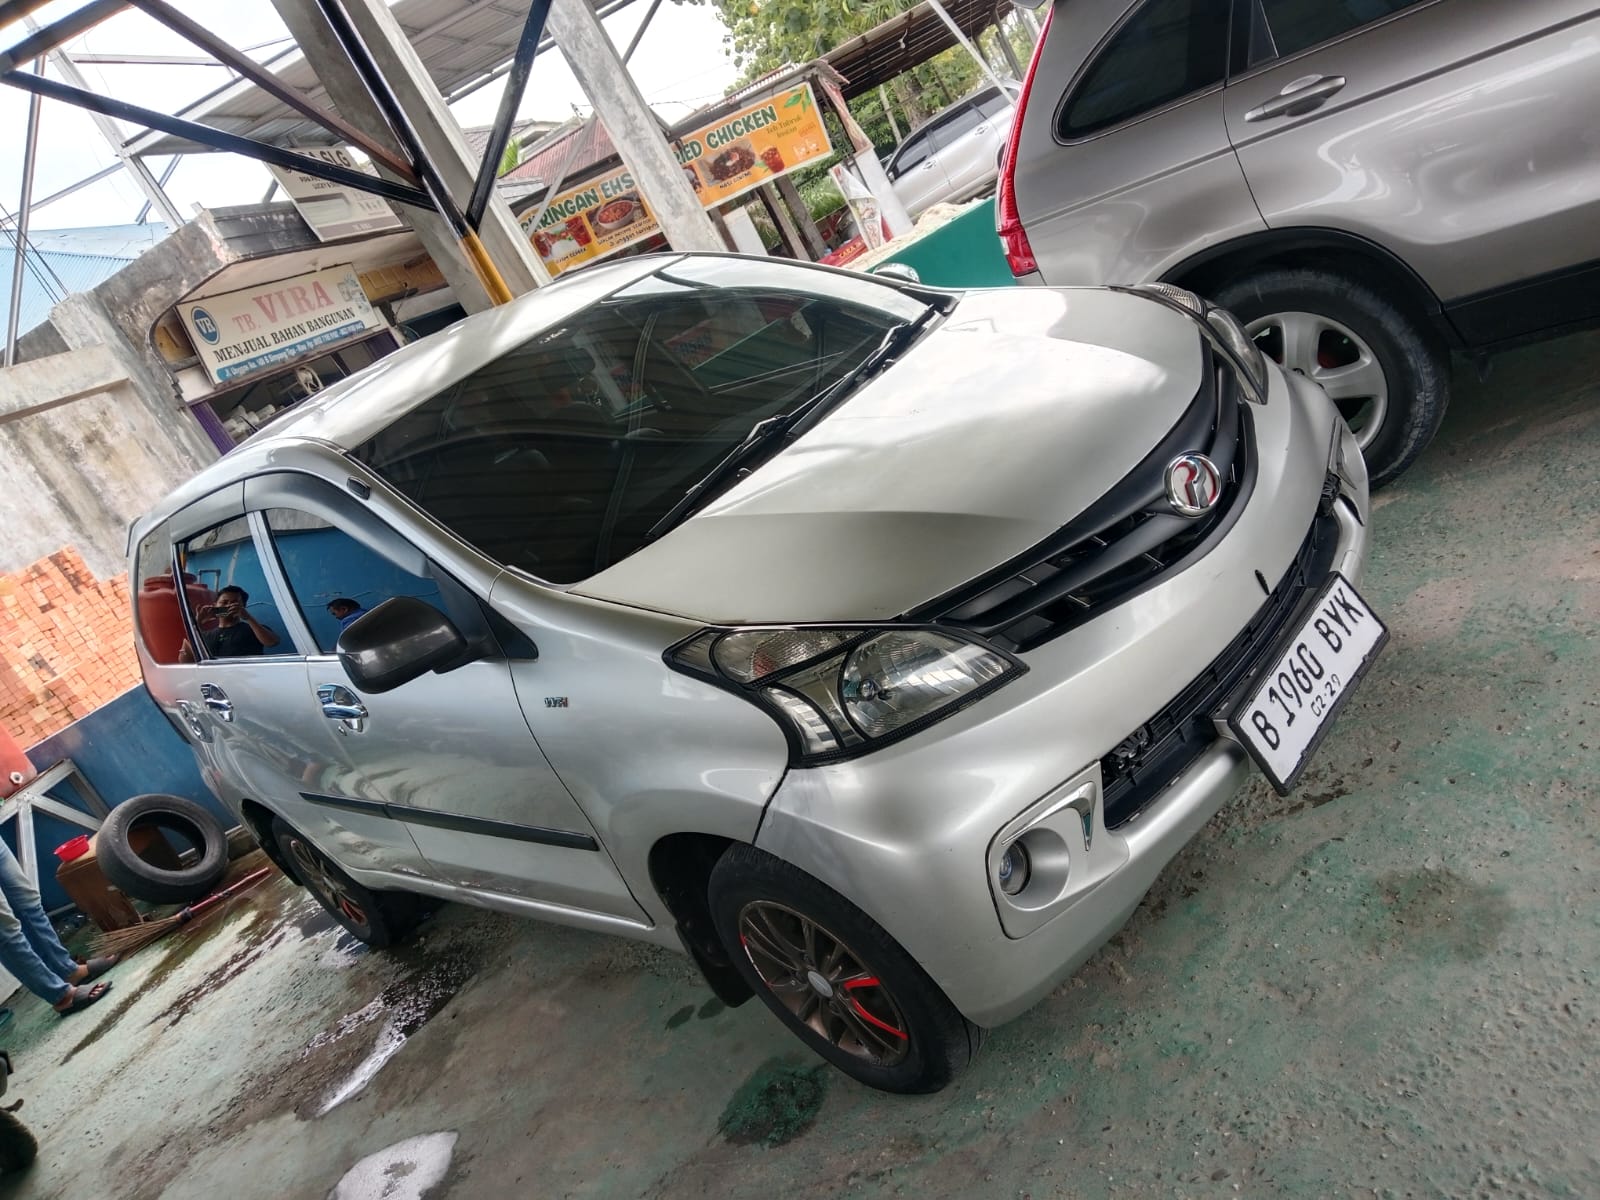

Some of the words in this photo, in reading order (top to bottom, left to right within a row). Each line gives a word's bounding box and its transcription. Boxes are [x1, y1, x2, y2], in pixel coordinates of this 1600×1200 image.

[706, 106, 777, 148] CHICKEN
[252, 280, 334, 323] VIRA
[195, 317, 216, 335] VR
[212, 335, 272, 363] MENJUAL
[271, 322, 307, 347] BAHAN
[306, 306, 356, 333] BANGUNAN
[1251, 710, 1280, 750] B
[1268, 643, 1324, 727] 1960
[1314, 587, 1364, 653] BYK
